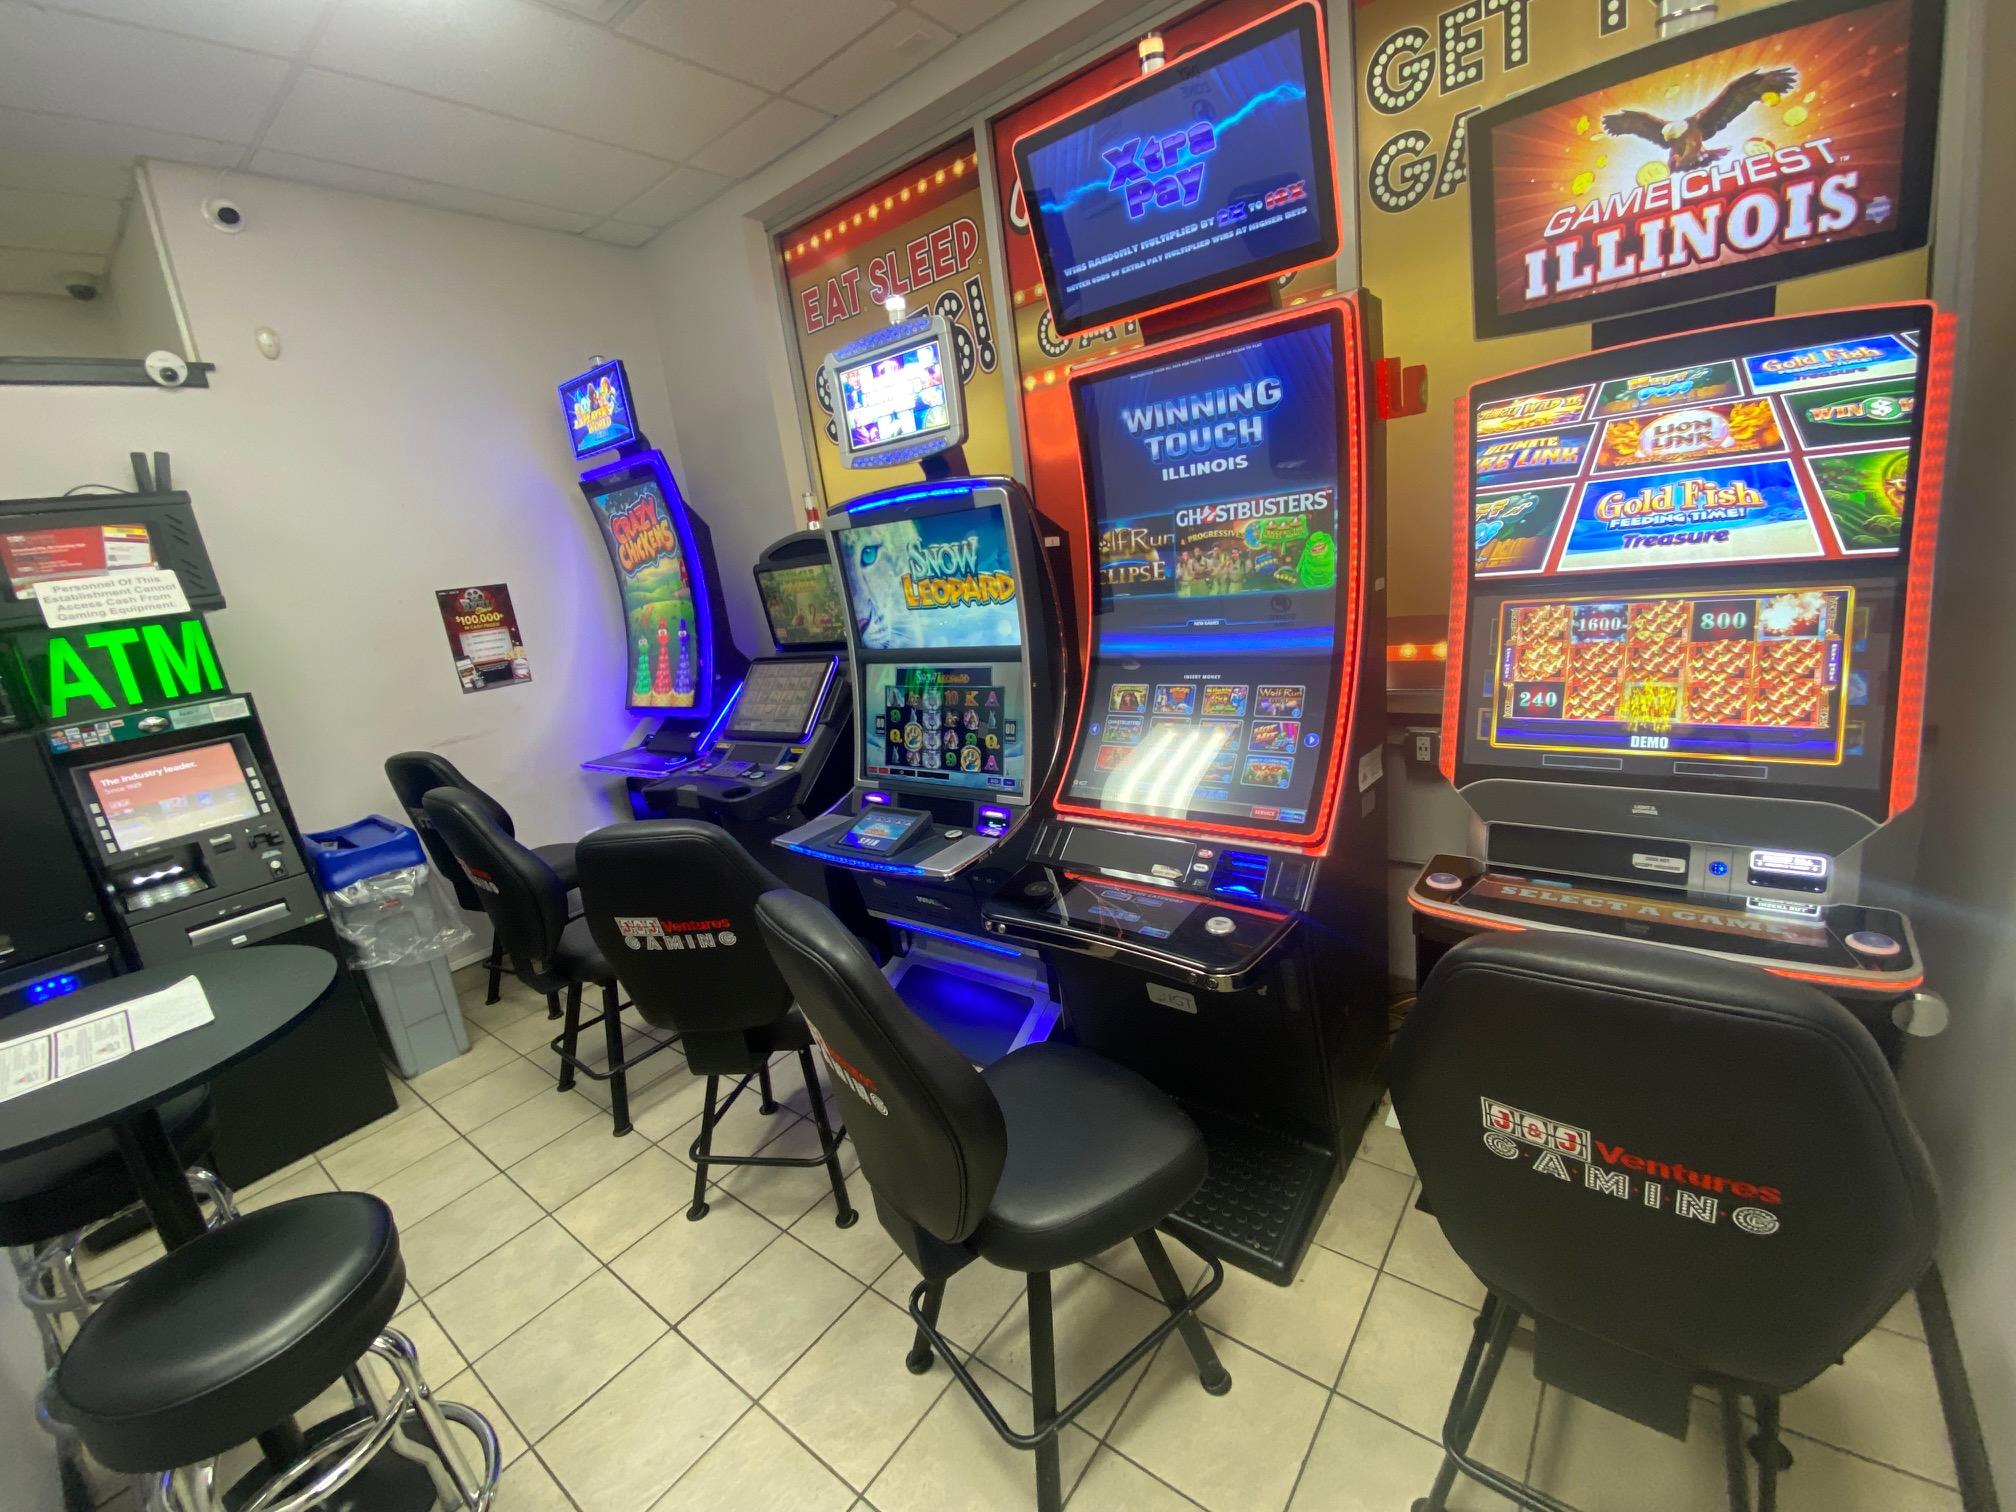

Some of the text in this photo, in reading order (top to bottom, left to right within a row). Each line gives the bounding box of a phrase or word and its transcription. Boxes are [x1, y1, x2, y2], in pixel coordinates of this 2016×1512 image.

[1365, 0, 1529, 115] GET
[1101, 121, 1217, 191] Xtra
[1125, 162, 1205, 219] Pay
[1088, 243, 1139, 268] RANDOMLY
[1140, 224, 1198, 250] MULTIPLIED
[1200, 216, 1215, 230] BY
[1121, 260, 1146, 275] EXTRA
[1164, 238, 1211, 261] MULTIPLIED
[1249, 213, 1284, 232] HIGHER
[1525, 171, 1859, 299] ILLINOIS
[802, 218, 978, 335] EAT SLEEP
[1762, 351, 1817, 372] Gold
[1122, 377, 1283, 435] WINNING
[1144, 415, 1264, 461] TOUCH
[1483, 436, 1558, 457] ULTIMATE
[1652, 432, 1714, 449] LINK
[1162, 454, 1249, 482] ILLINOIS
[1514, 447, 1579, 468] LINK
[1597, 478, 1765, 521] Gold Fish
[611, 495, 657, 545] CRAZY
[1609, 508, 1747, 531] FEEDING TIME!
[618, 519, 675, 571] CHICKENS
[1622, 529, 1729, 551] Treasure
[906, 536, 979, 579] SNOW
[42, 584, 177, 605] Establishment Cannot
[52, 575, 161, 594] Personnel Of This
[901, 570, 1017, 610] LEOPARD
[57, 602, 176, 623] Gaming Equipment
[58, 593, 172, 612] Access Cash From
[1578, 611, 1748, 632] 1600 800
[50, 619, 224, 718] ATM
[1520, 692, 1558, 708] 240
[1630, 735, 1669, 751] DEMO
[100, 777, 120, 788] The
[164, 760, 199, 774] leader.
[1501, 885, 1628, 912] SELECT
[1638, 906, 1661, 916] A
[661, 918, 731, 932] Ventures
[1486, 1101, 1782, 1206] J&J Ventures
